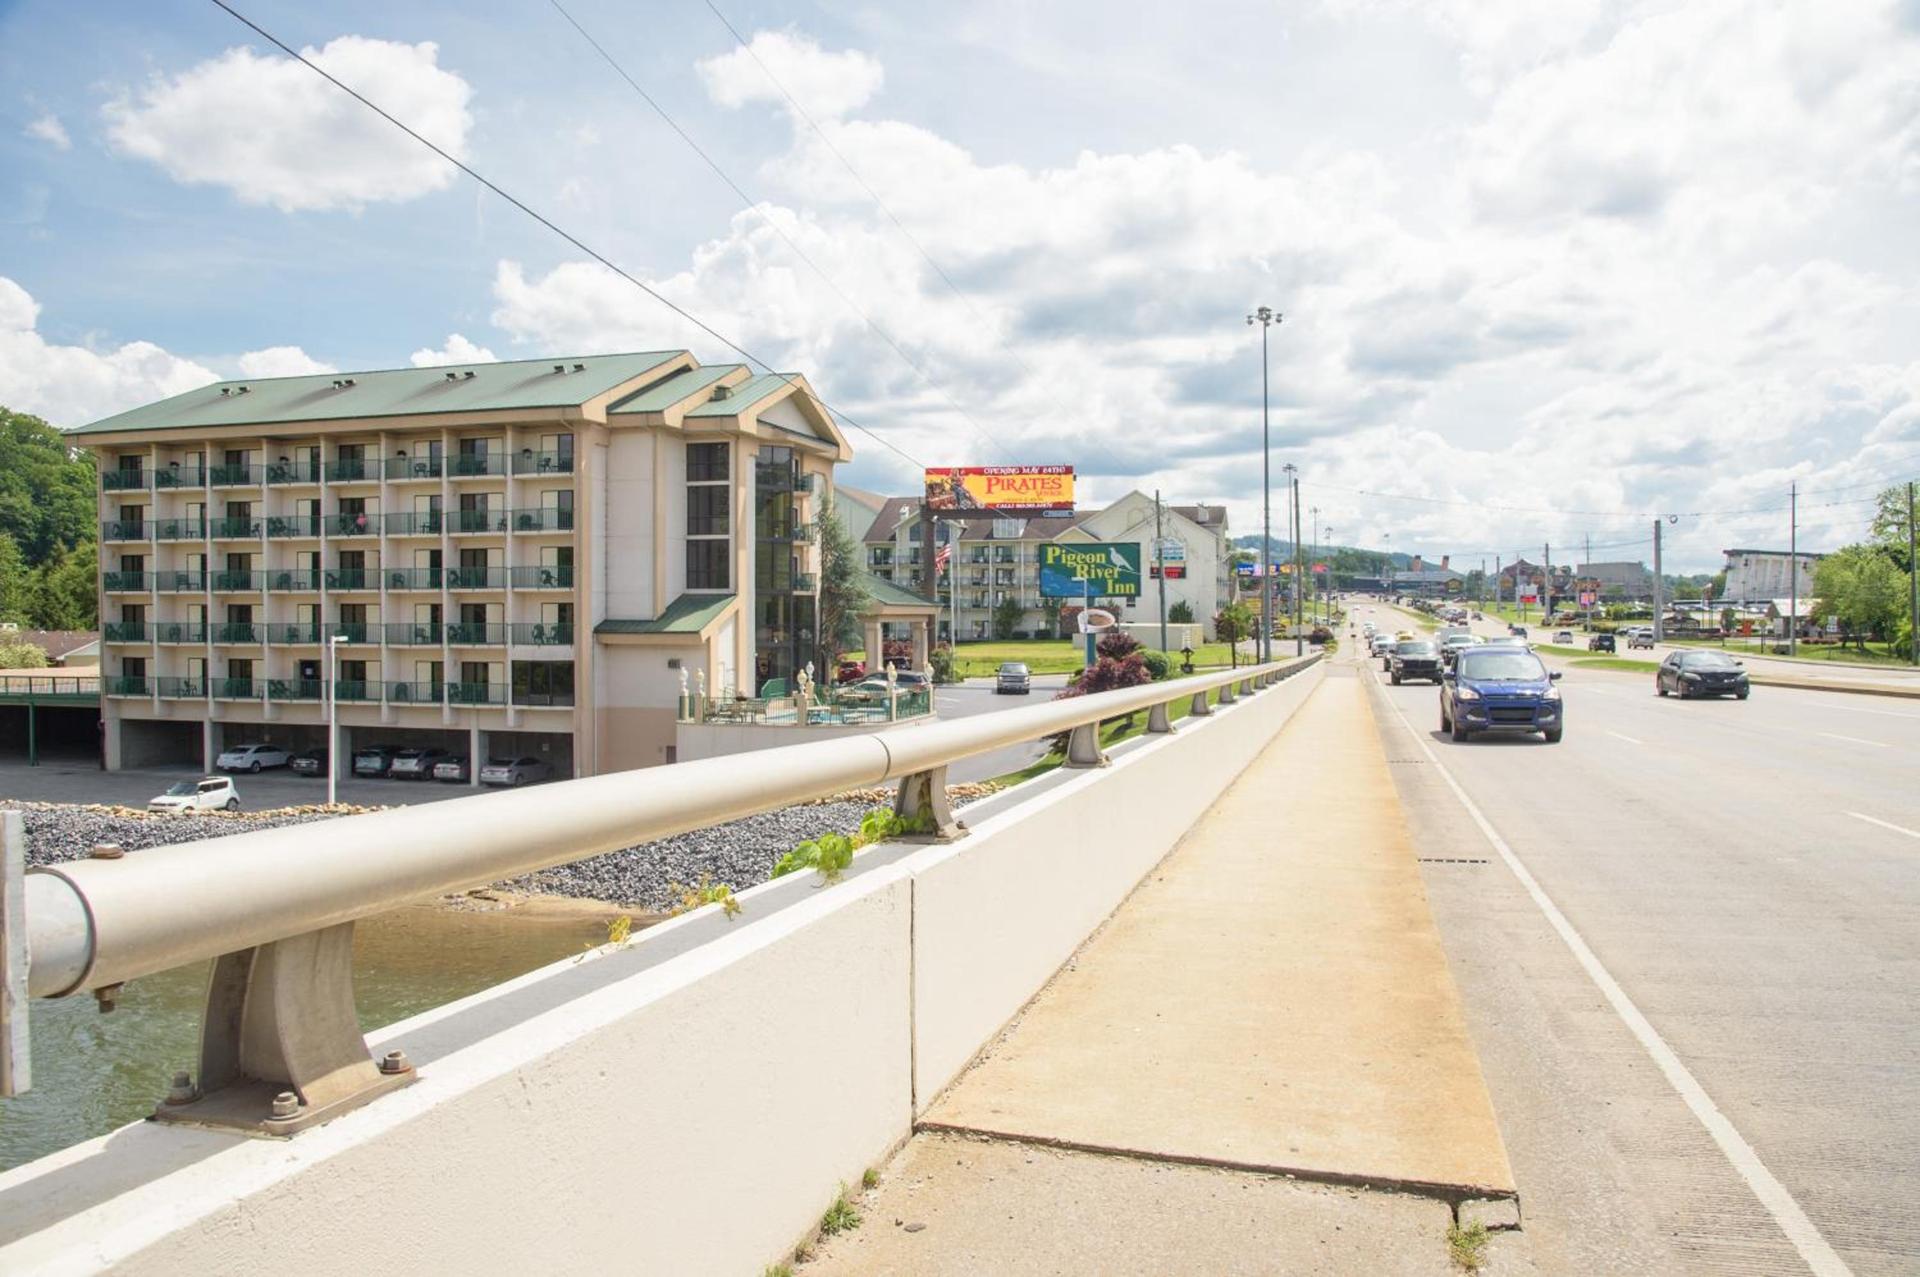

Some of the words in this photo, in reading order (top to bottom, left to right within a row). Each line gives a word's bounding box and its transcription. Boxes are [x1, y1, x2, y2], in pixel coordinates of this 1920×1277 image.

[984, 467, 1019, 475] OPENING
[1022, 466, 1039, 474] MAY
[985, 476, 1062, 495] PIRATES
[1045, 546, 1106, 568] Pigeon
[1075, 563, 1120, 579] River
[1106, 579, 1136, 594] Inn
